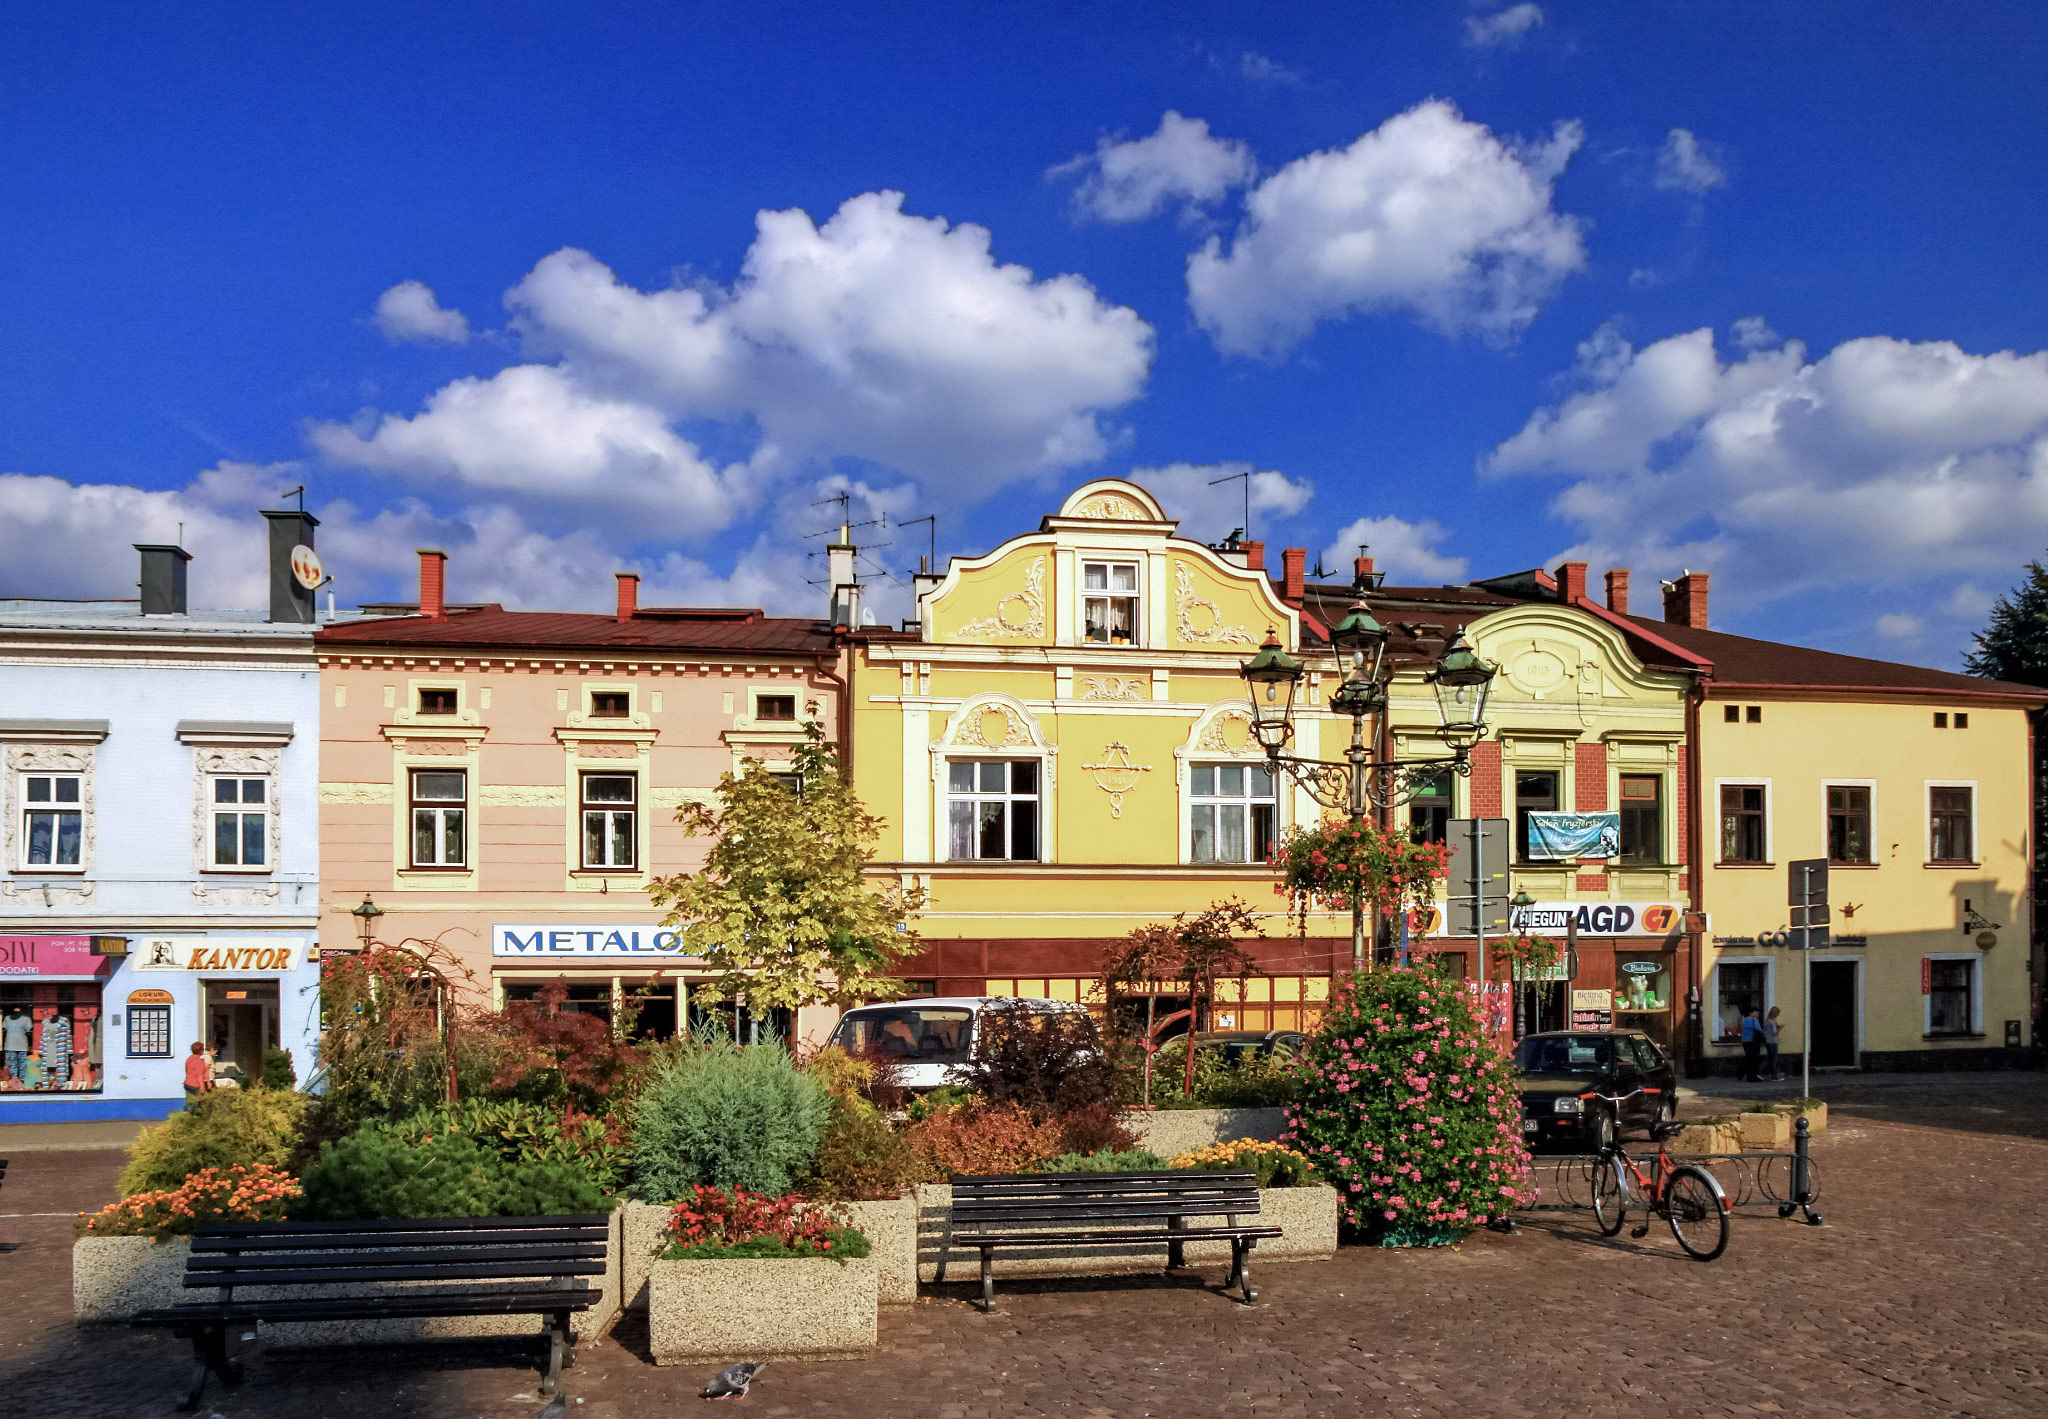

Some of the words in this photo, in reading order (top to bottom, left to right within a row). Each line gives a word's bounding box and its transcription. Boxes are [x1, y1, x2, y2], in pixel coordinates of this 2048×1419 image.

[1535, 818, 1559, 827] Salon
[1562, 818, 1601, 830] fryzjerski
[1574, 905, 1635, 933] AGD
[503, 929, 683, 952] METALO
[1758, 924, 1791, 946] GÓ
[187, 947, 292, 970] KANTOR
